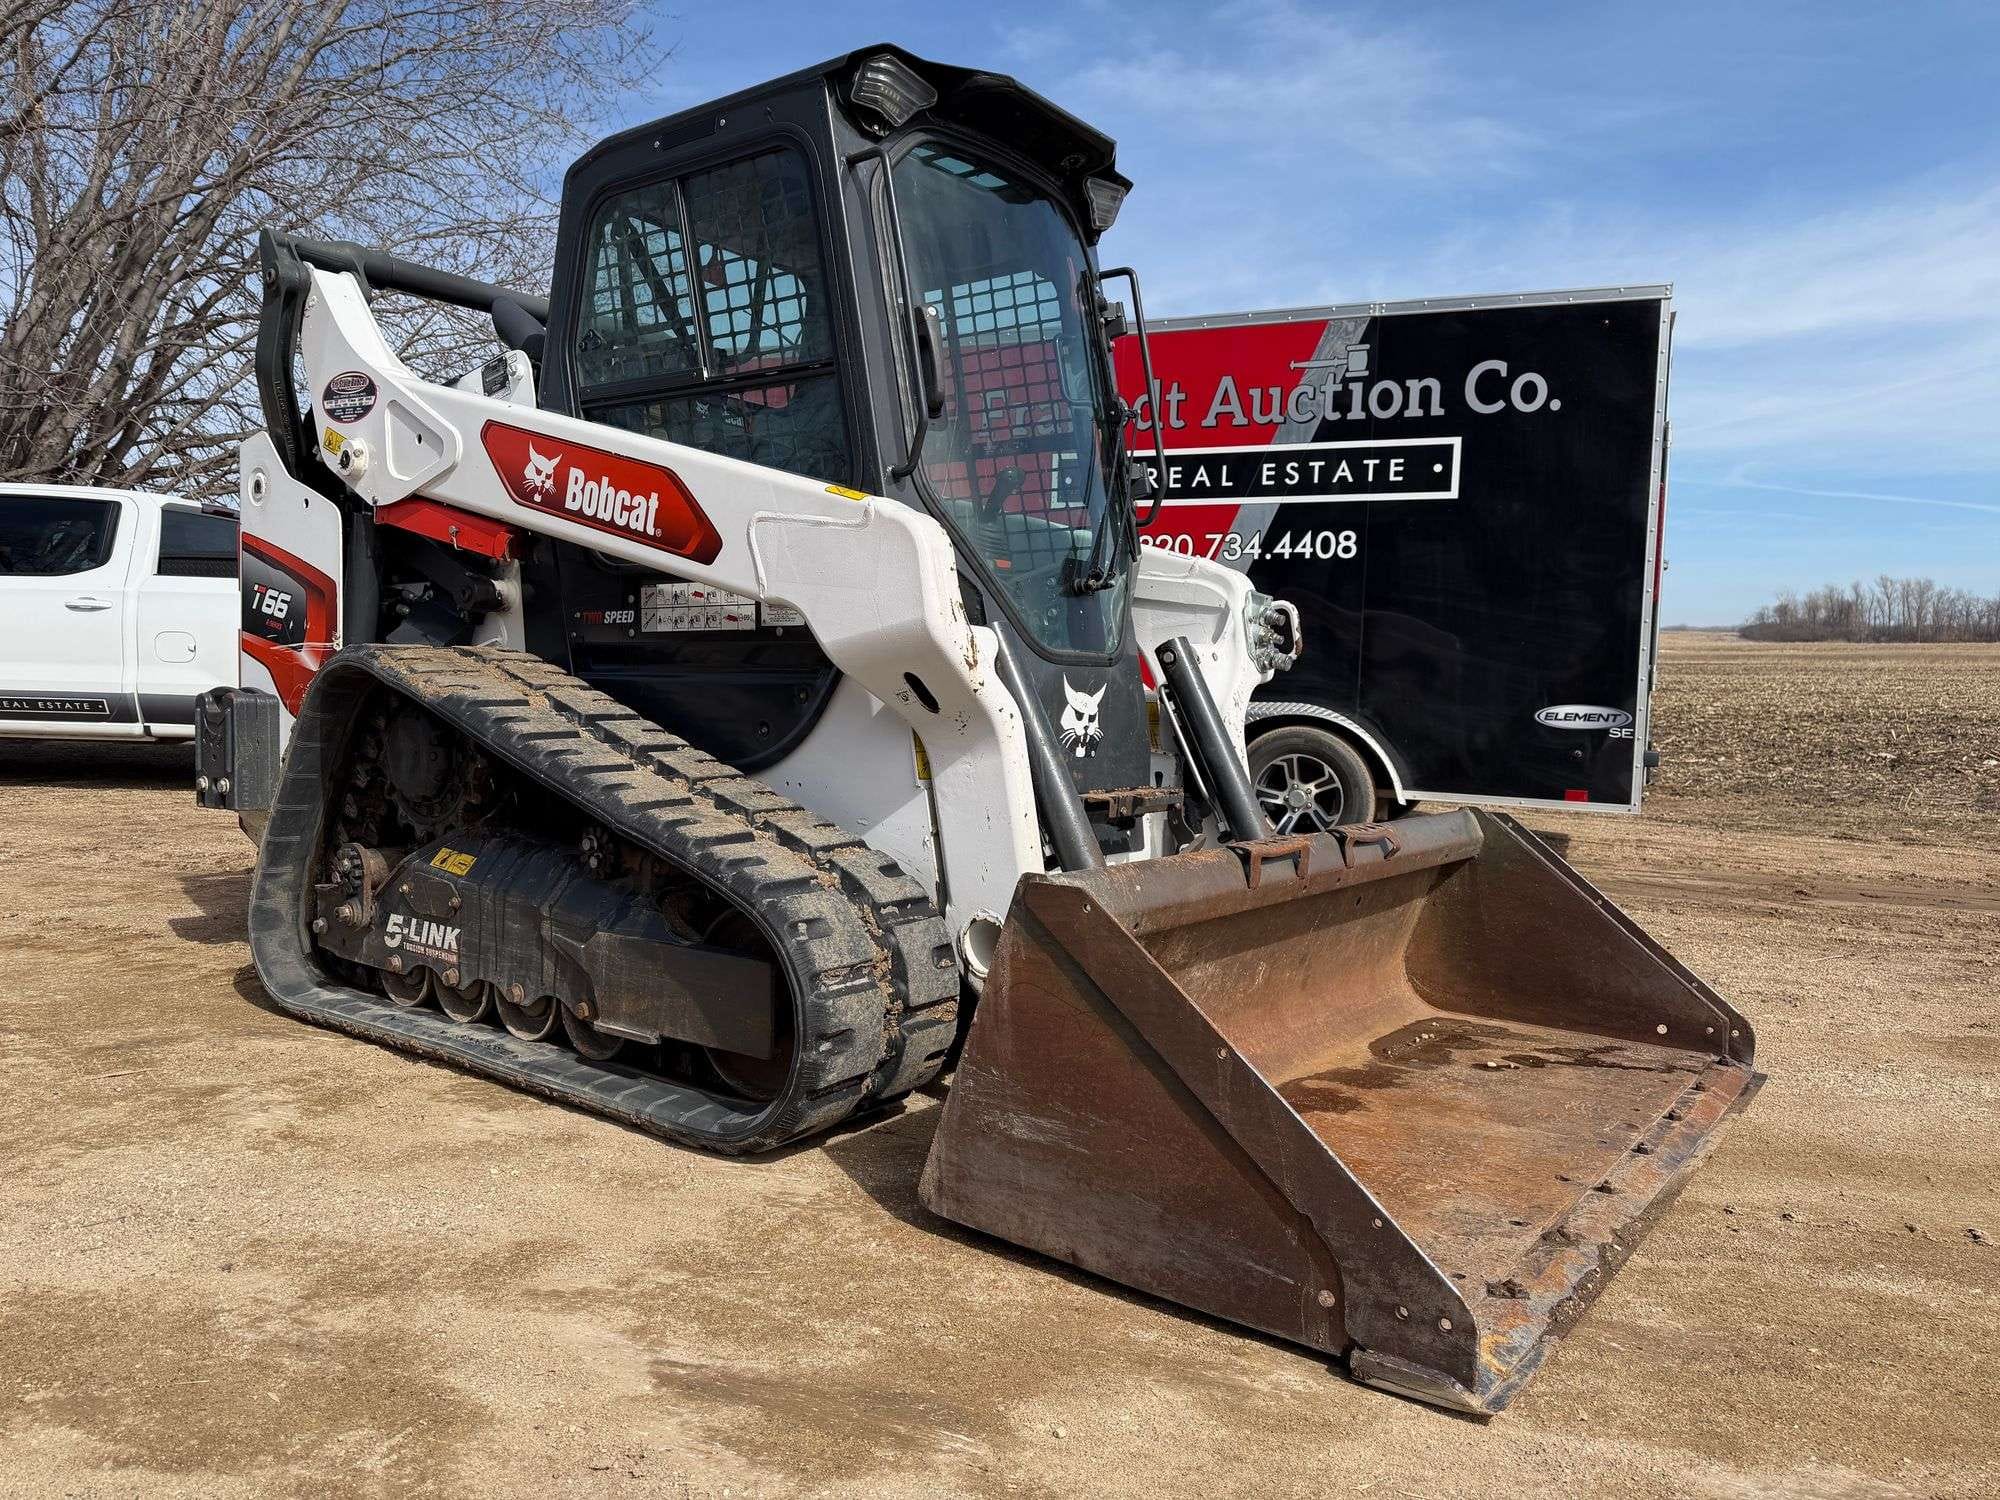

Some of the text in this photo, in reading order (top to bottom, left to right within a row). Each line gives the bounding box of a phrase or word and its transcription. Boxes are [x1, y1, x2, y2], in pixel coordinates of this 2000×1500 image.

[1201, 367, 1445, 428] Auction
[1464, 359, 1563, 414] Co.
[1262, 458, 1405, 486] ESTATE
[564, 466, 659, 536] Bobcat
[604, 610, 635, 624] SPEED
[0, 701, 91, 710] EAL ESTATE
[1544, 712, 1622, 722] ELEMENT
[1608, 727, 1634, 739] SE
[384, 913, 461, 950] 5-LINK
